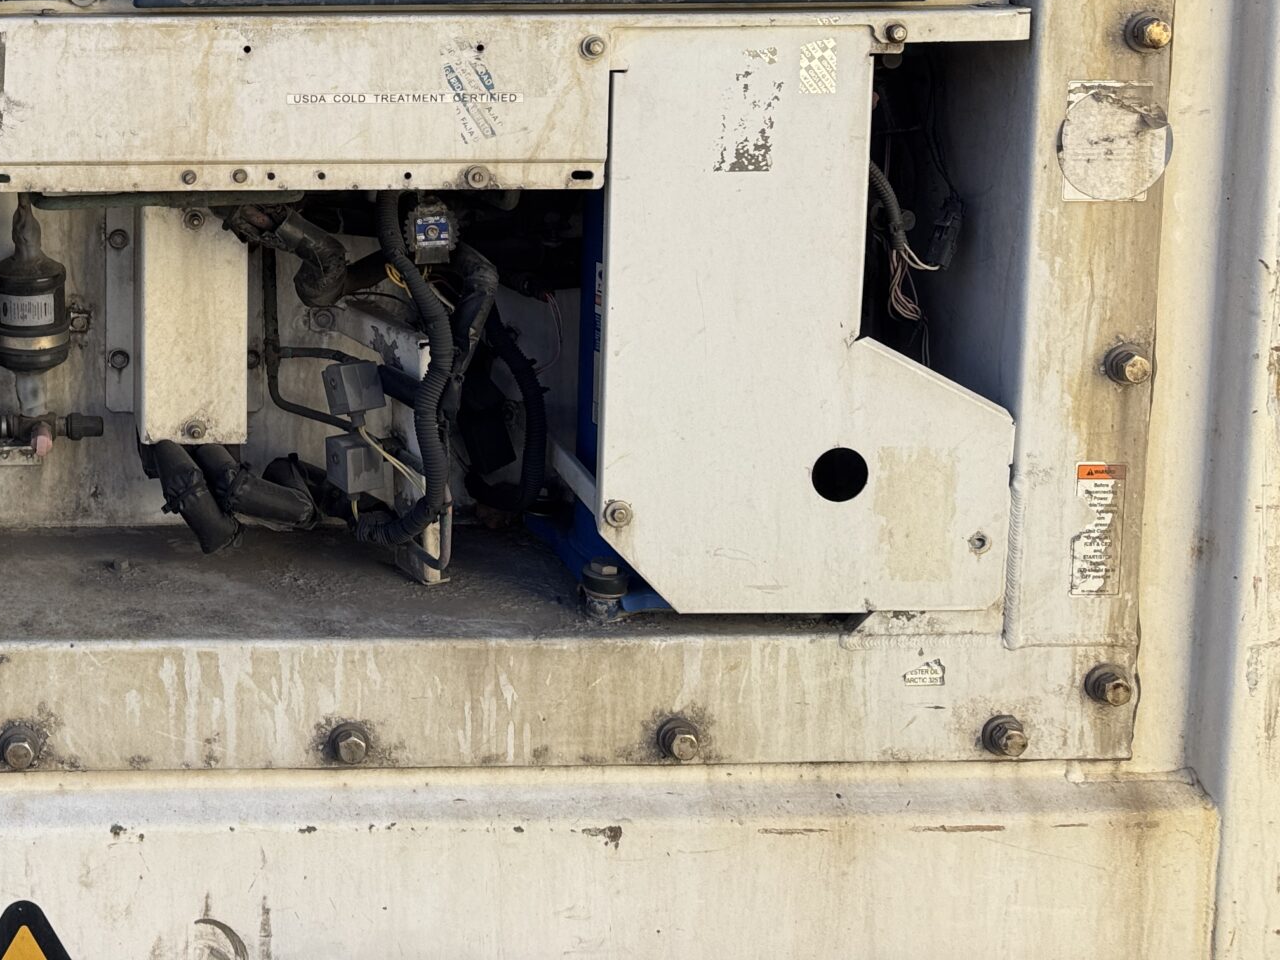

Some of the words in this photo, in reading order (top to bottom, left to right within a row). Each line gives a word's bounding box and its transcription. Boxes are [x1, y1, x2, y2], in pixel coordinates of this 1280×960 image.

[293, 95, 327, 103] USDA
[333, 94, 366, 103] COLD
[373, 94, 445, 103] TREATMENT
